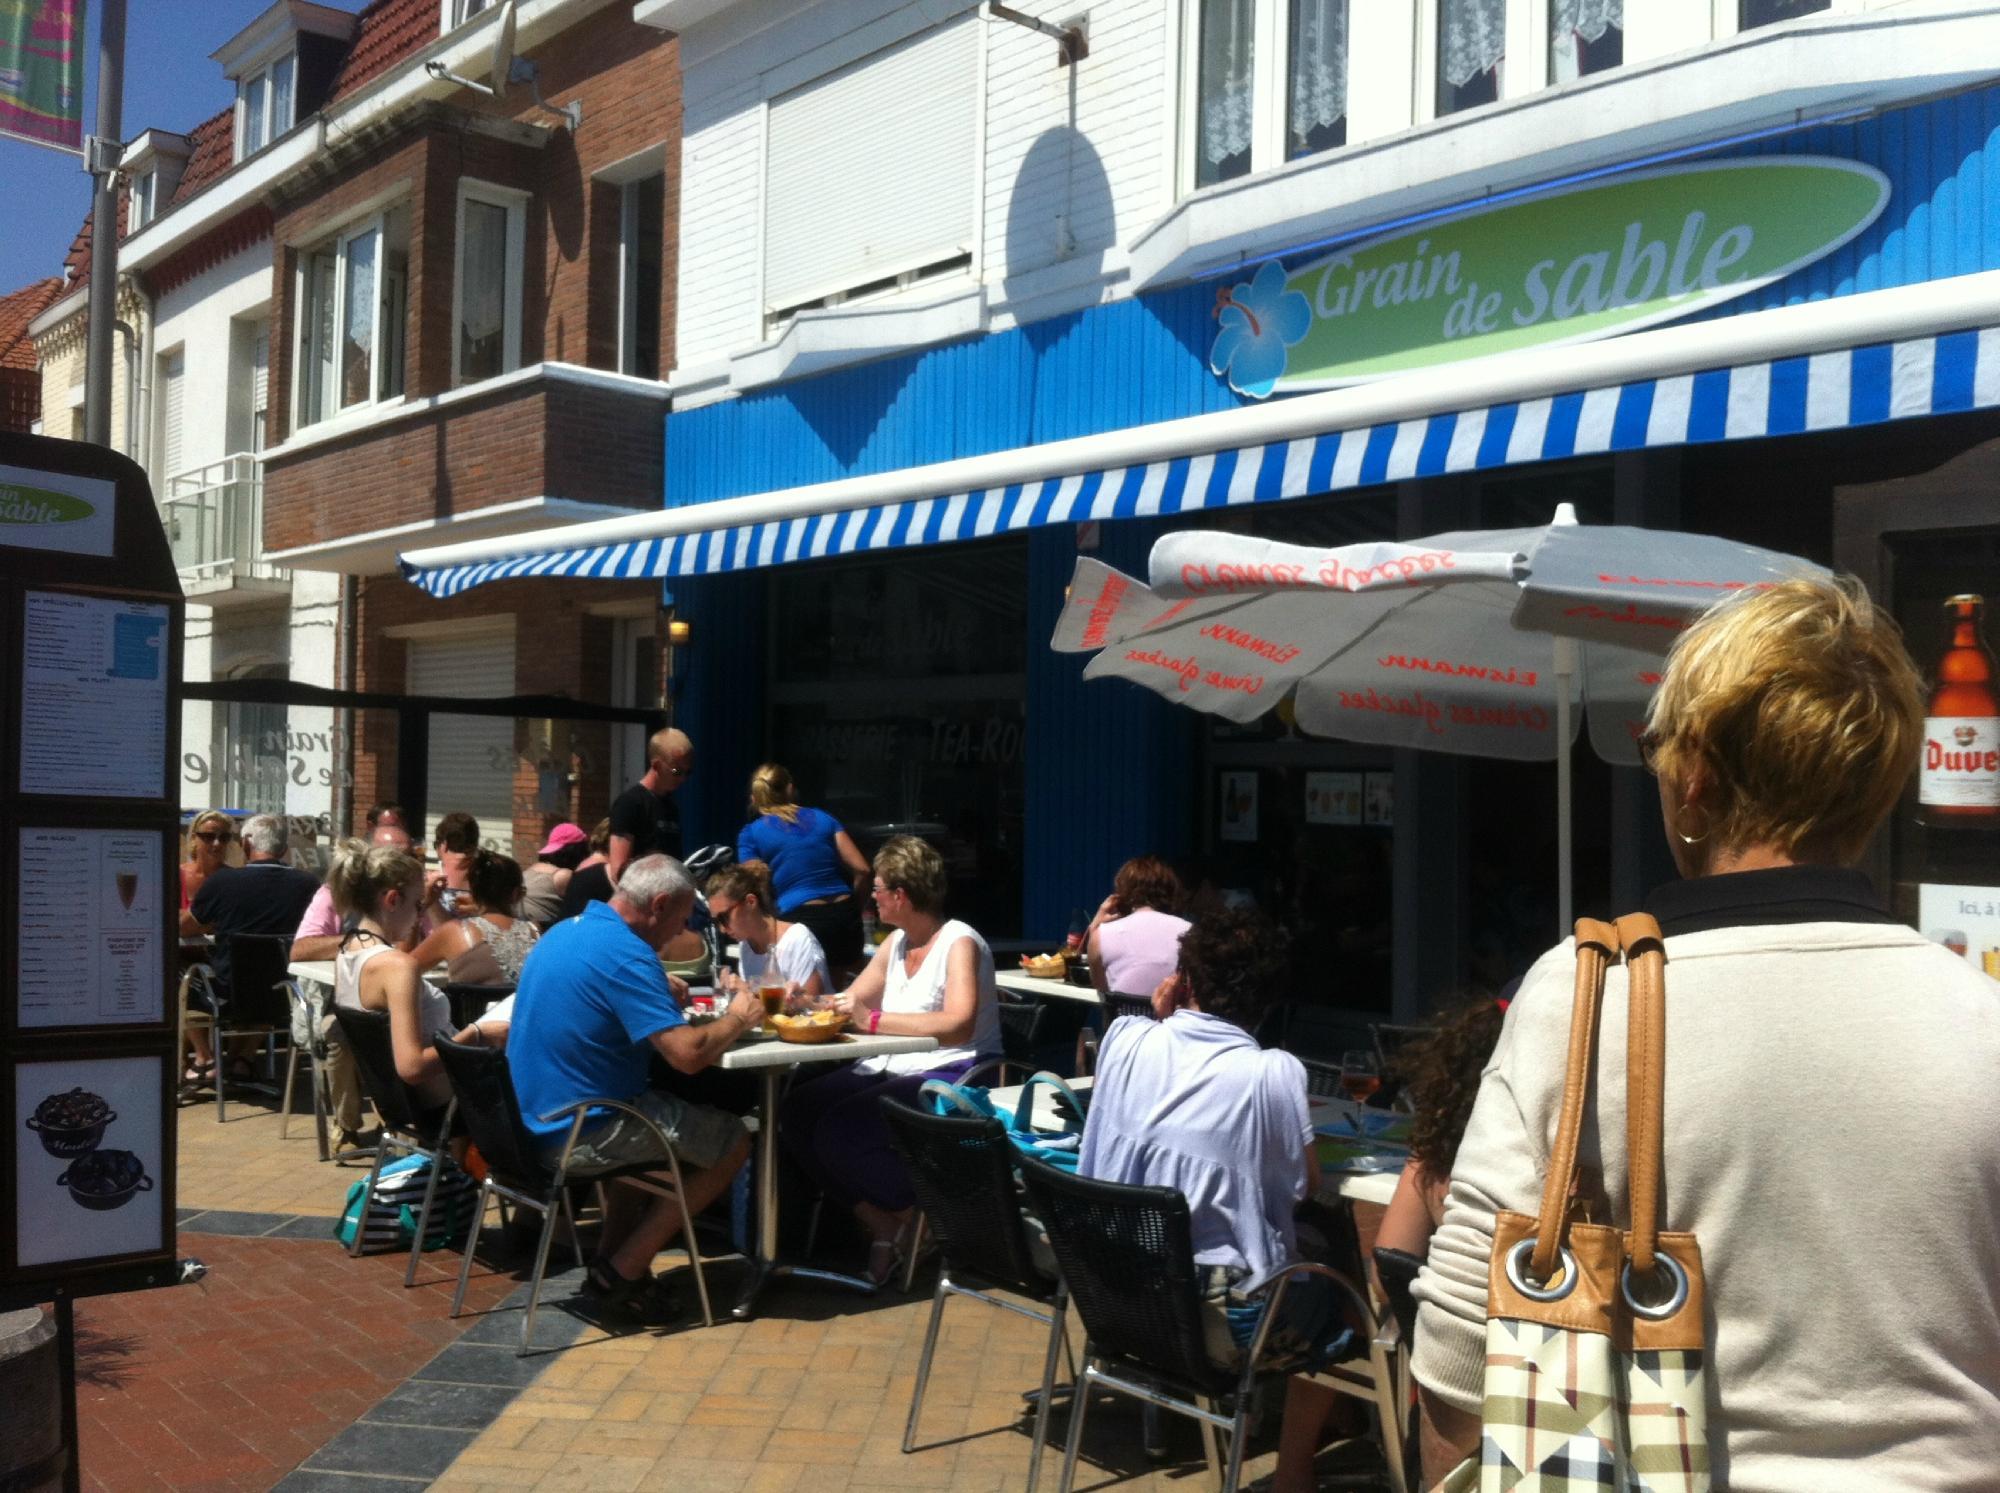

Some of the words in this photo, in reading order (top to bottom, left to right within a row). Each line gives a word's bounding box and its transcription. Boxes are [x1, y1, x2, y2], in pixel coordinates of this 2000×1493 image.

[1315, 239, 1463, 320] Grain
[1443, 282, 1503, 339] de
[1511, 210, 1755, 327] sable
[1927, 737, 2000, 773] Duve
